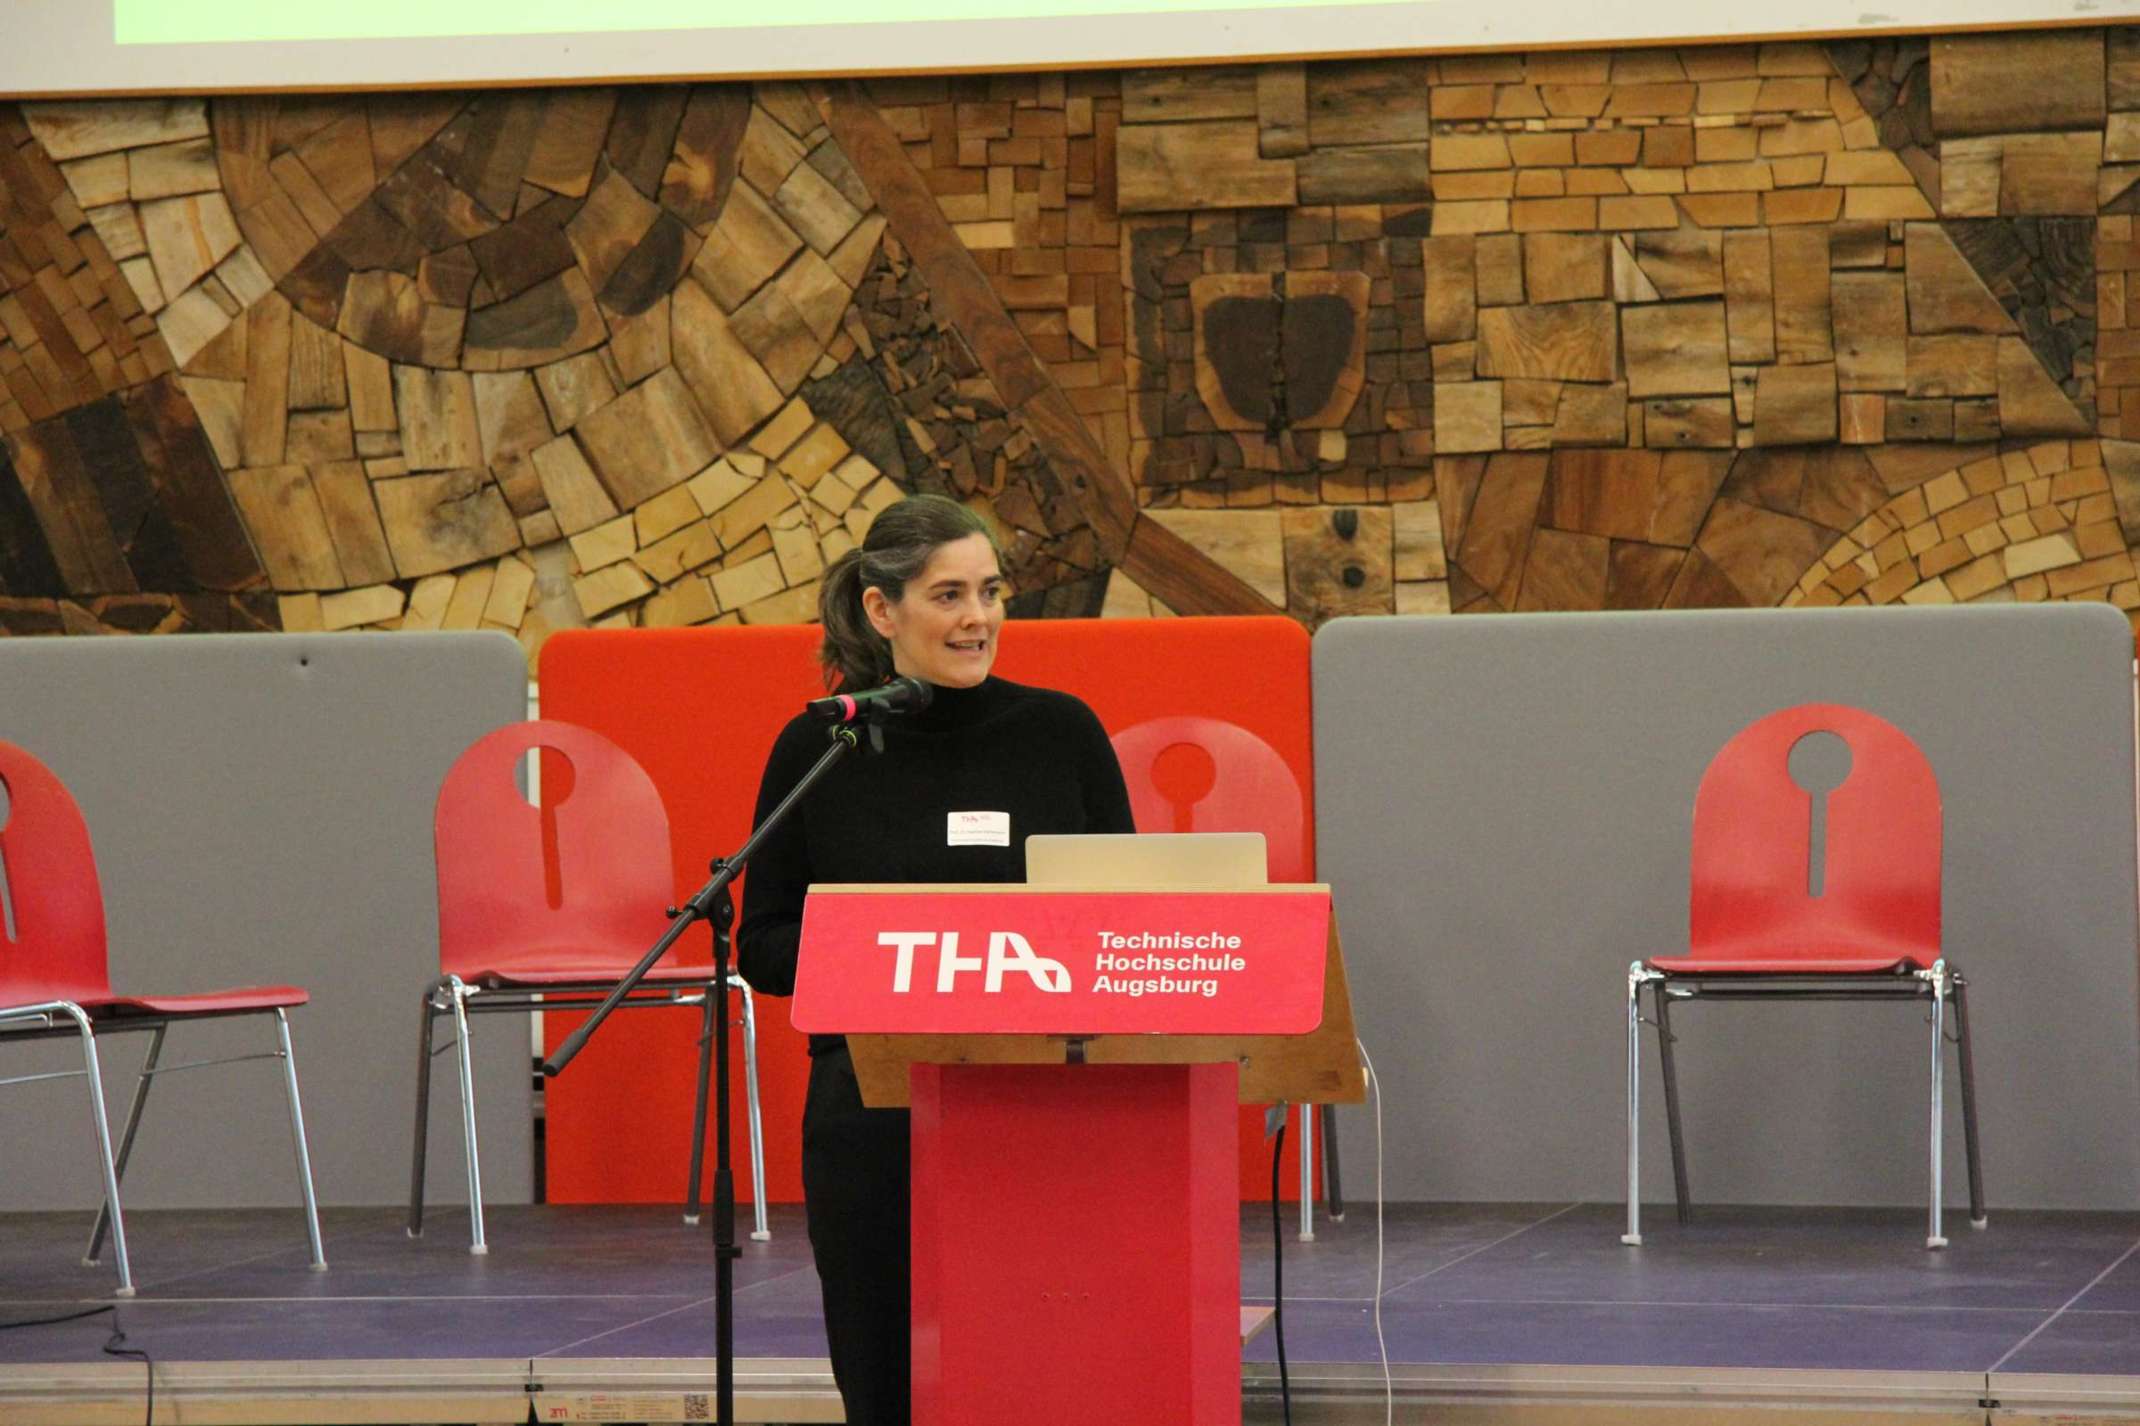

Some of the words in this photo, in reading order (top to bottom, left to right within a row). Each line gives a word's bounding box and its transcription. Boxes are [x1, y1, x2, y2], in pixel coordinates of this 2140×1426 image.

[1097, 931, 1242, 949] Technische
[877, 931, 1072, 993] THA
[1095, 953, 1246, 971] Hochschule
[1092, 975, 1218, 997] Augsburg
